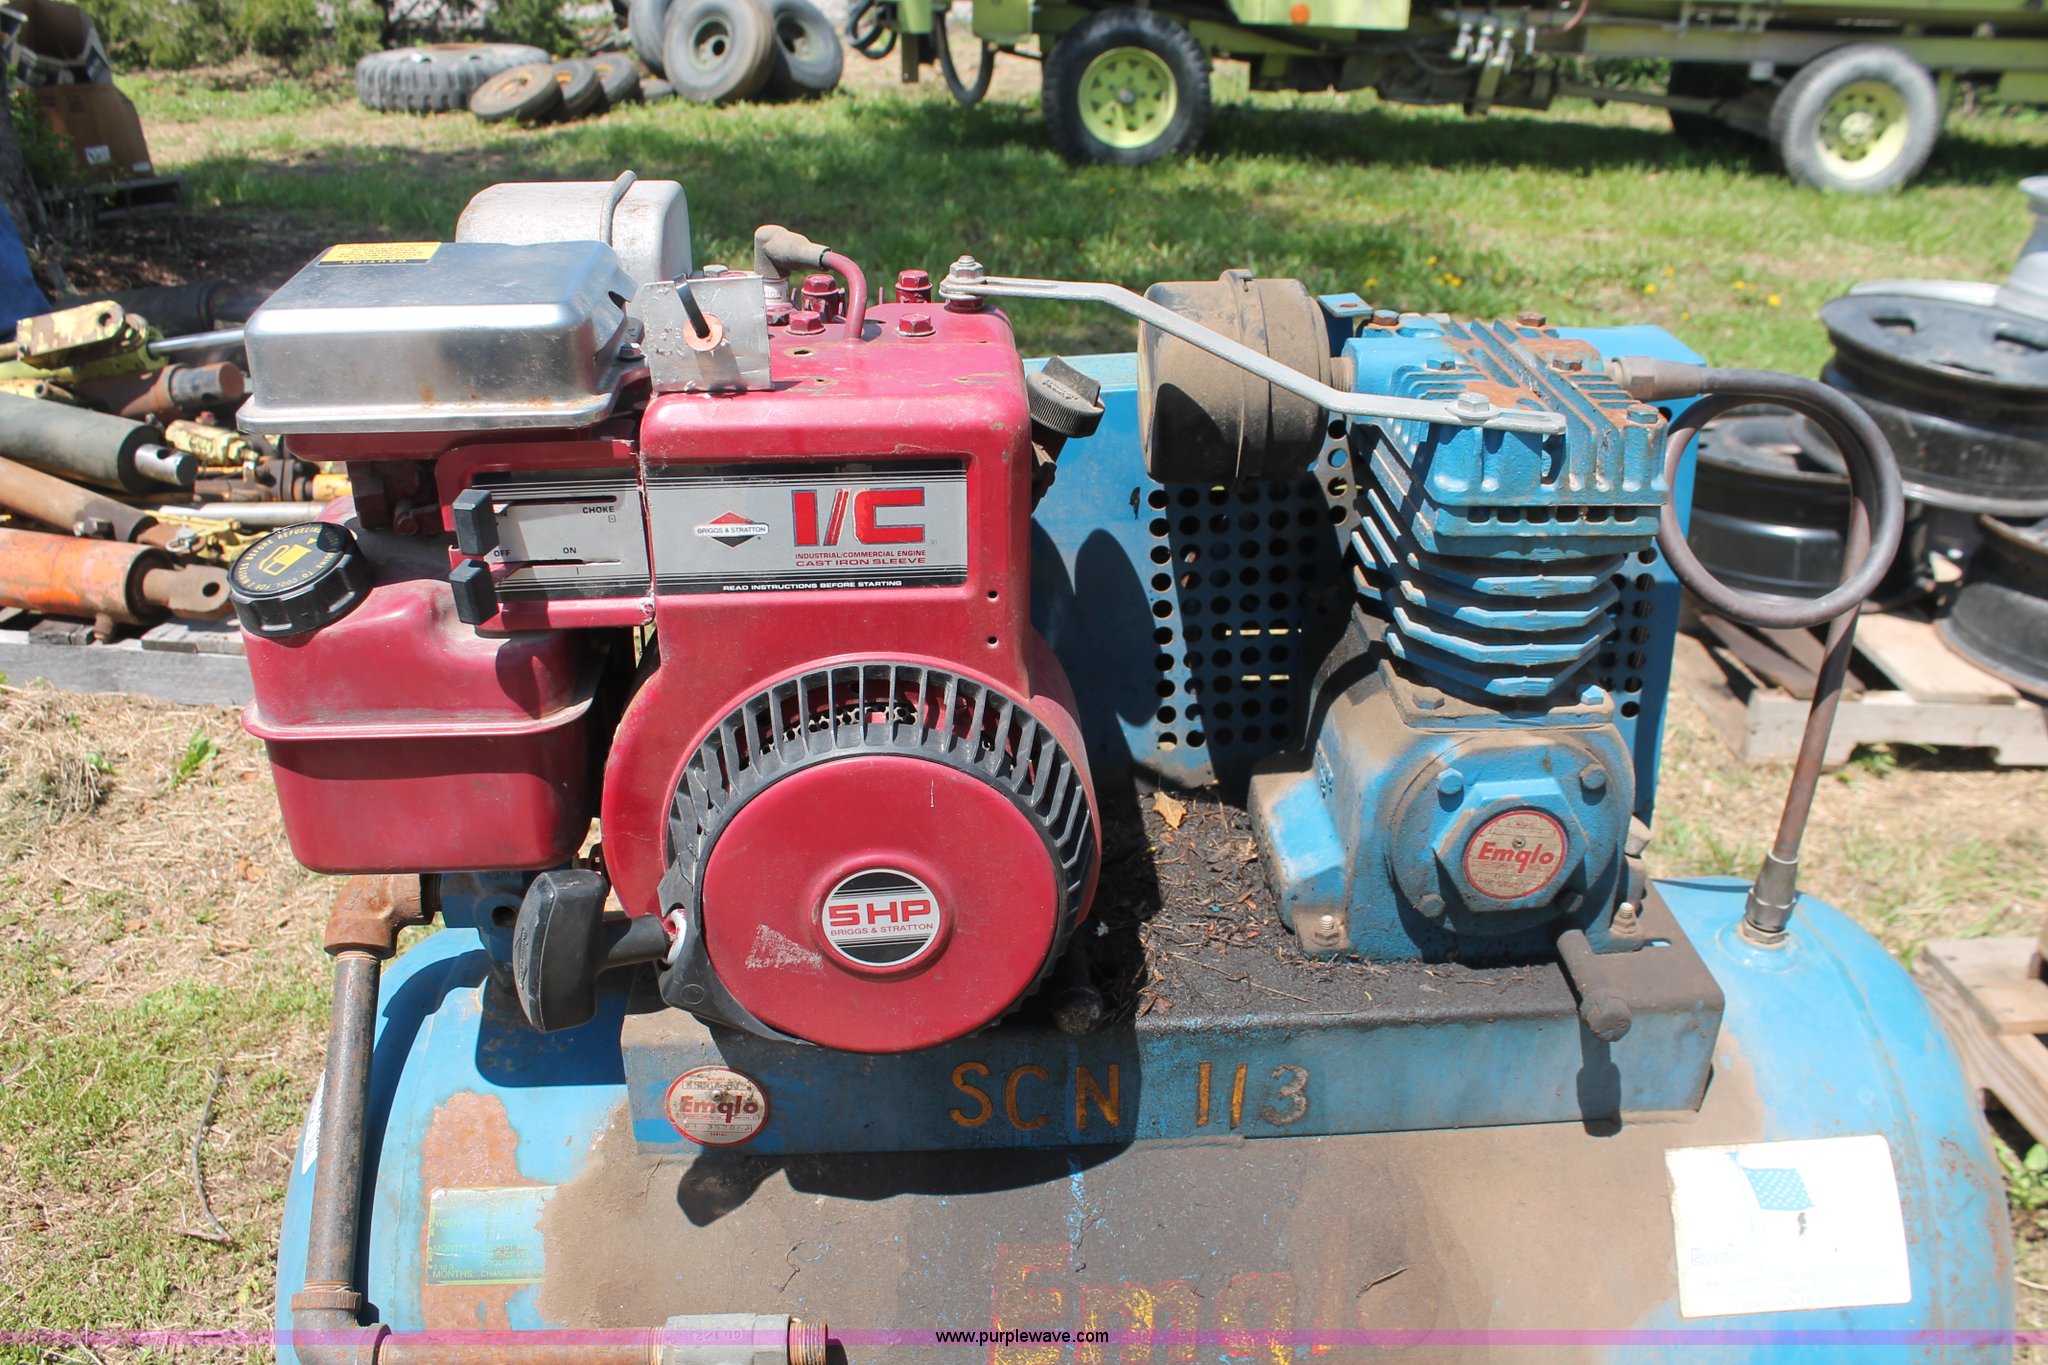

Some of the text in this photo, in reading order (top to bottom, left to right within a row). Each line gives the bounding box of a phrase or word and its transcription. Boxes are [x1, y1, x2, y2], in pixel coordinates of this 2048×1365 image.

[582, 506, 615, 514] CHOKE
[795, 549, 926, 559] INDUSTRIAL/COMMERCIAL ENGINE
[858, 580, 902, 588] STARTING
[830, 927, 868, 937] BRIGGS
[880, 923, 934, 933] STRATTON
[432, 1269, 473, 1279] MONTHS
